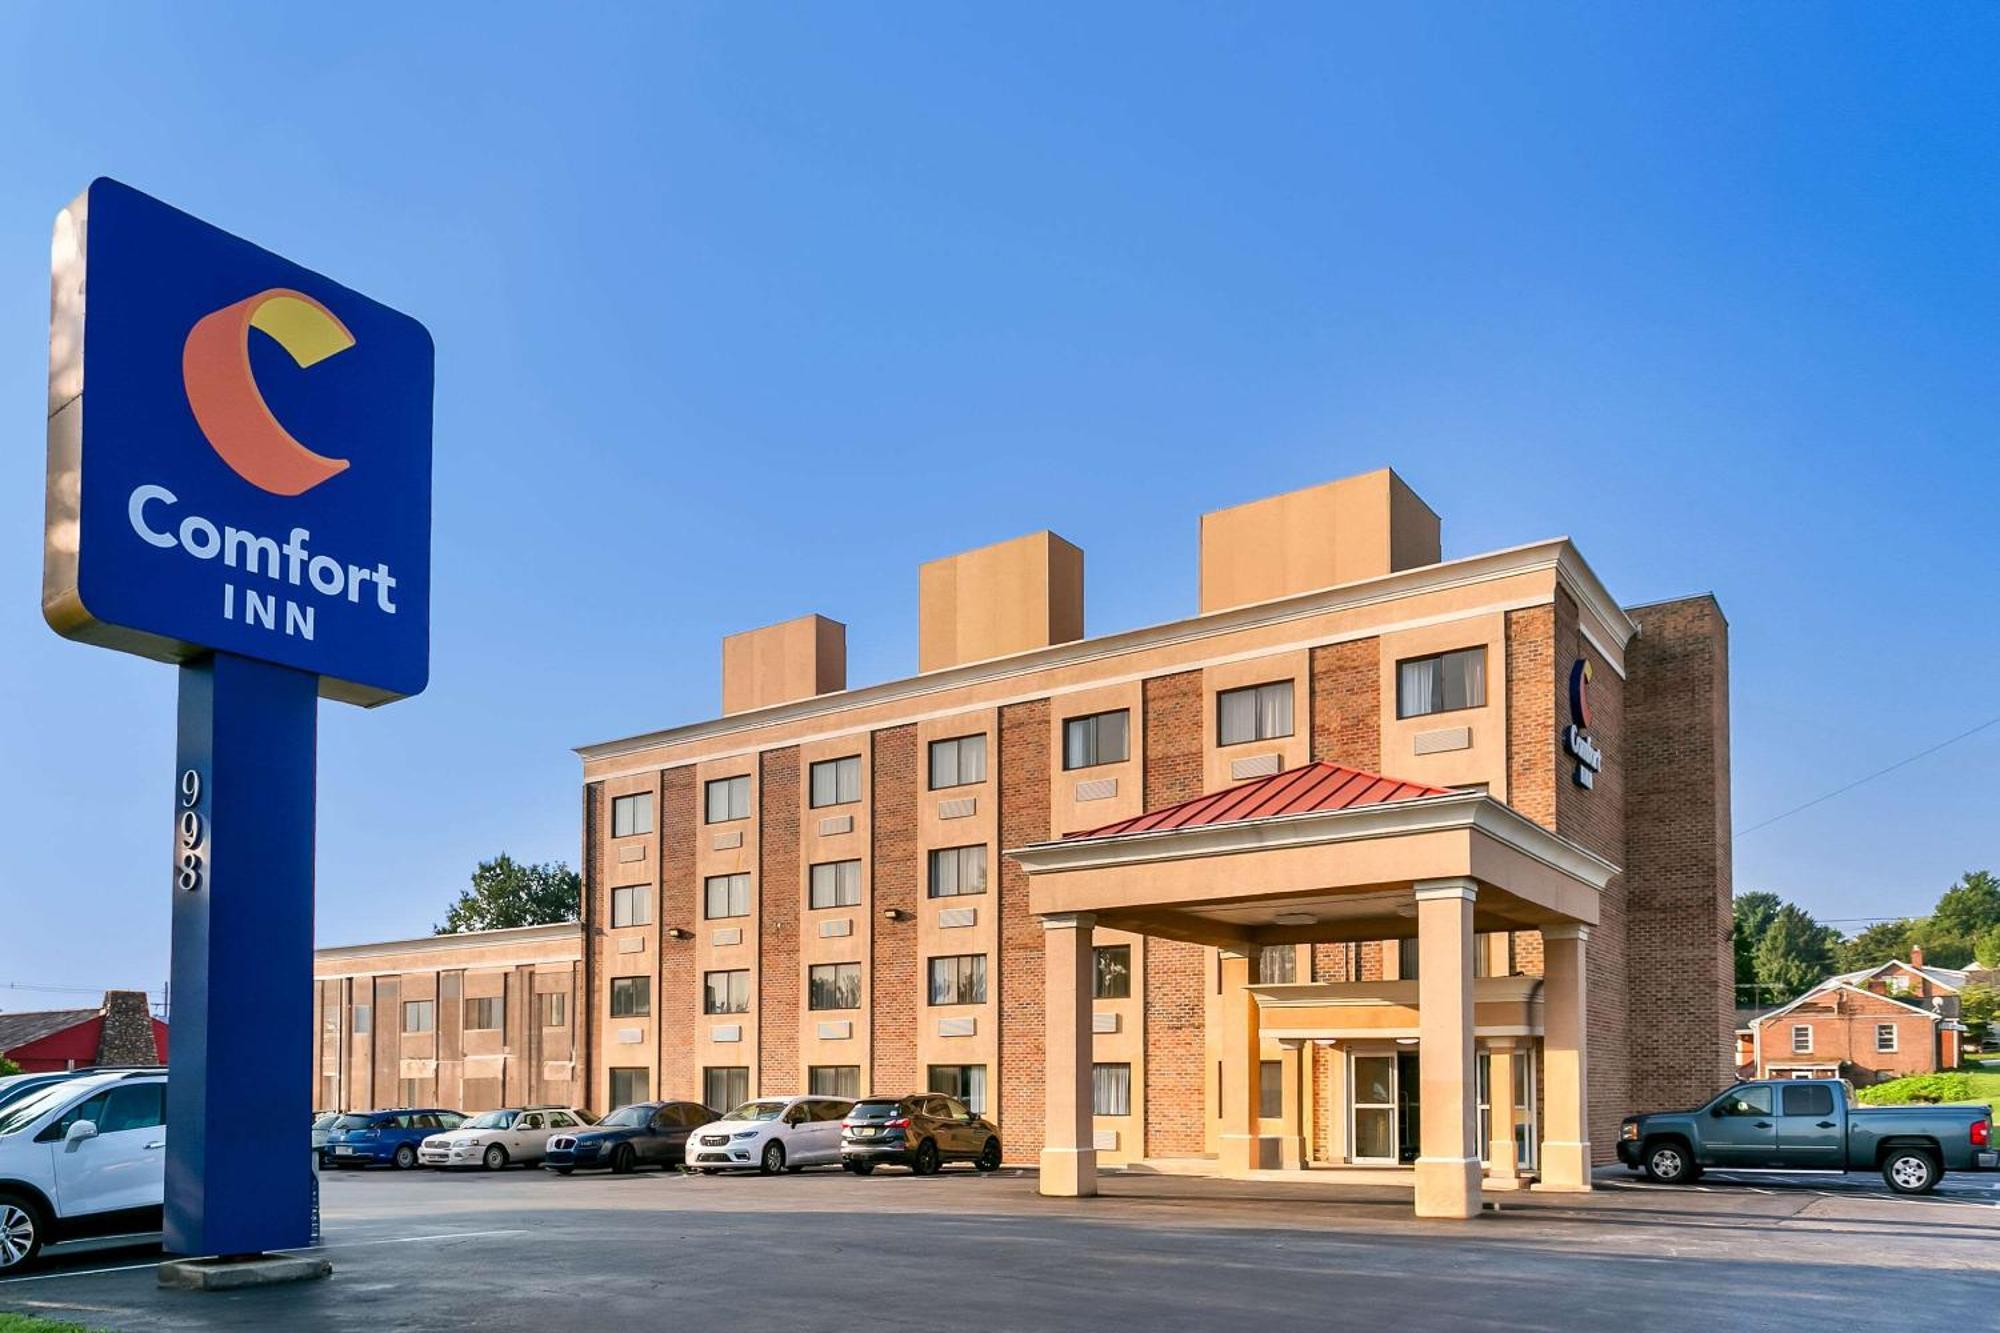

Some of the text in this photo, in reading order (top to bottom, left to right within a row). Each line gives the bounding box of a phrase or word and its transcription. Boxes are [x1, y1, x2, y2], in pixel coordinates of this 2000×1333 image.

[128, 484, 396, 614] Comfort
[224, 583, 315, 641] INN
[179, 769, 200, 890] 998
